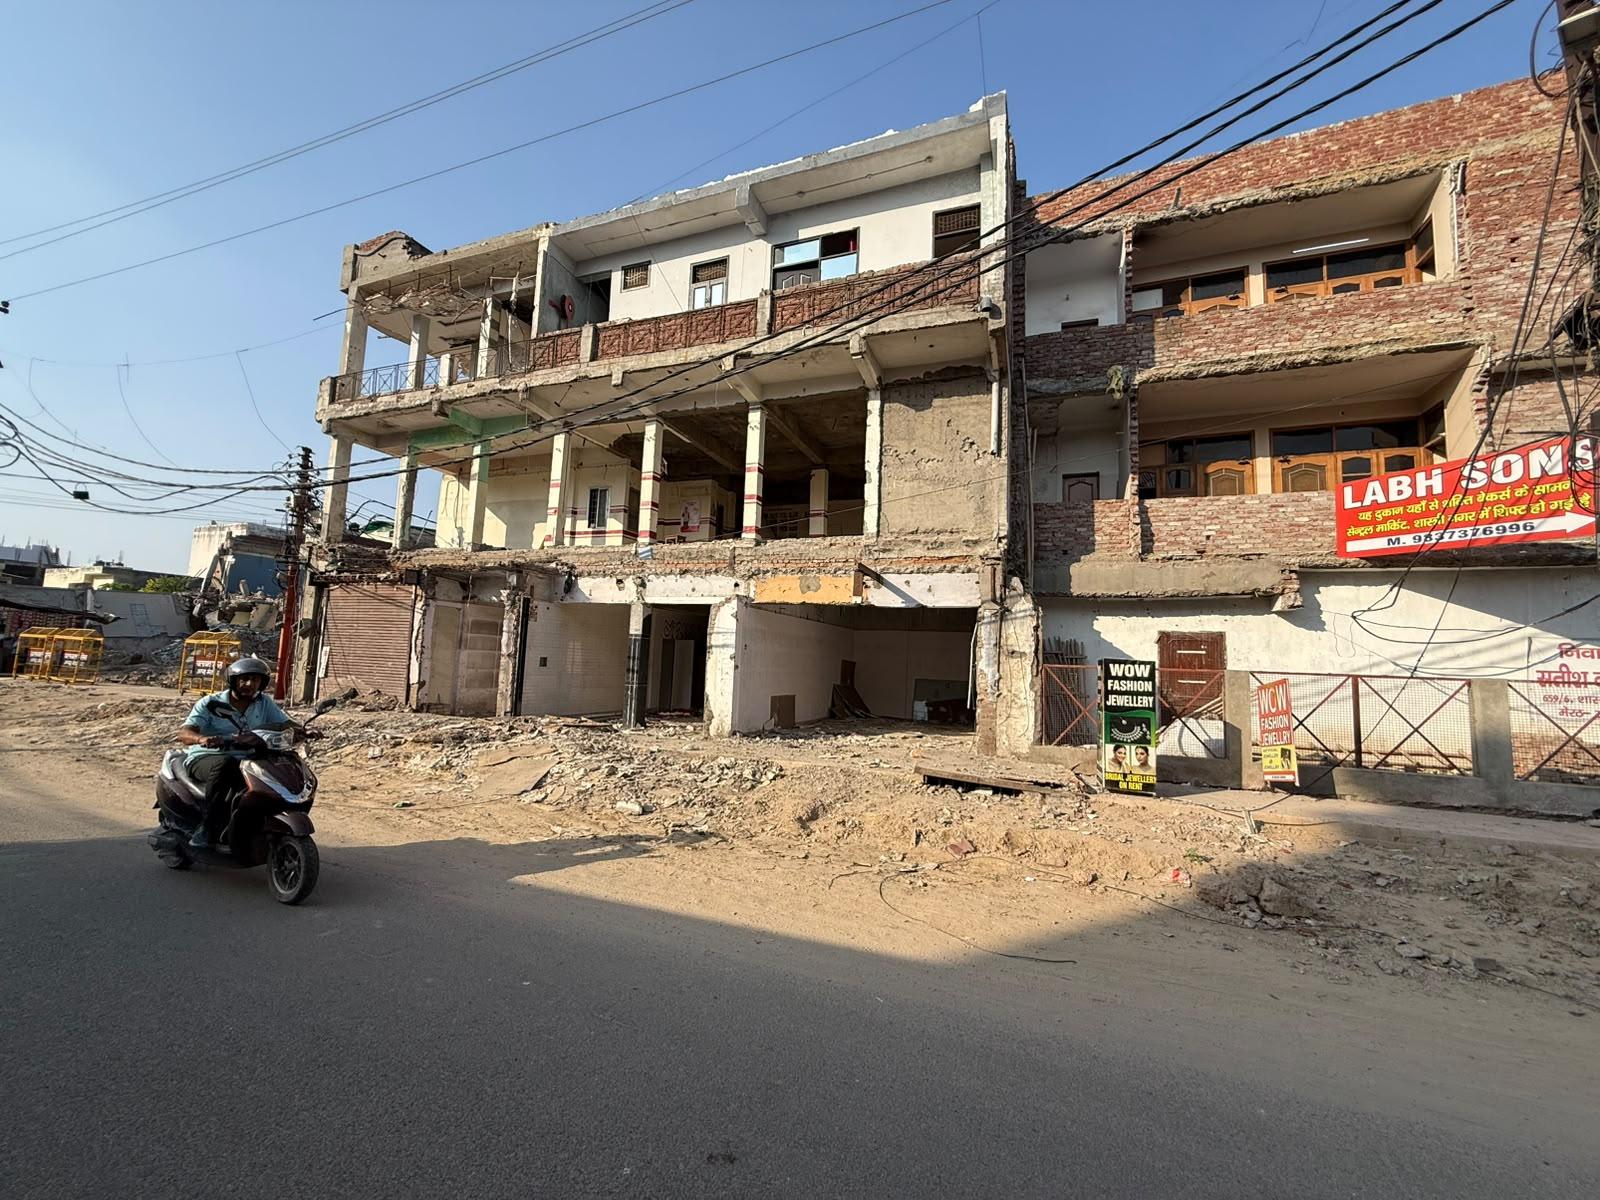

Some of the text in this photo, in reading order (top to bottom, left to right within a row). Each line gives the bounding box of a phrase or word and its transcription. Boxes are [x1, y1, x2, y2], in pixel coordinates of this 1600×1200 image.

[1343, 438, 1595, 509] LABH SONS
[1357, 510, 1373, 521] यह
[1375, 506, 1404, 521] दुकान
[1429, 498, 1439, 511] से
[1515, 485, 1530, 497] के
[1478, 506, 1493, 520] में
[1529, 499, 1546, 515] हो
[1413, 521, 1536, 544] 9837376996
[1557, 642, 1600, 660] निवा
[1109, 663, 1151, 678] WOW
[1107, 679, 1153, 692] FASHION
[1105, 694, 1154, 708] JEWELLERY
[1258, 683, 1288, 716] WOW
[1260, 714, 1290, 731] FASHION
[1104, 772, 1157, 784] BRIDAL JEWELLERY
[1128, 782, 1143, 791] RENT
